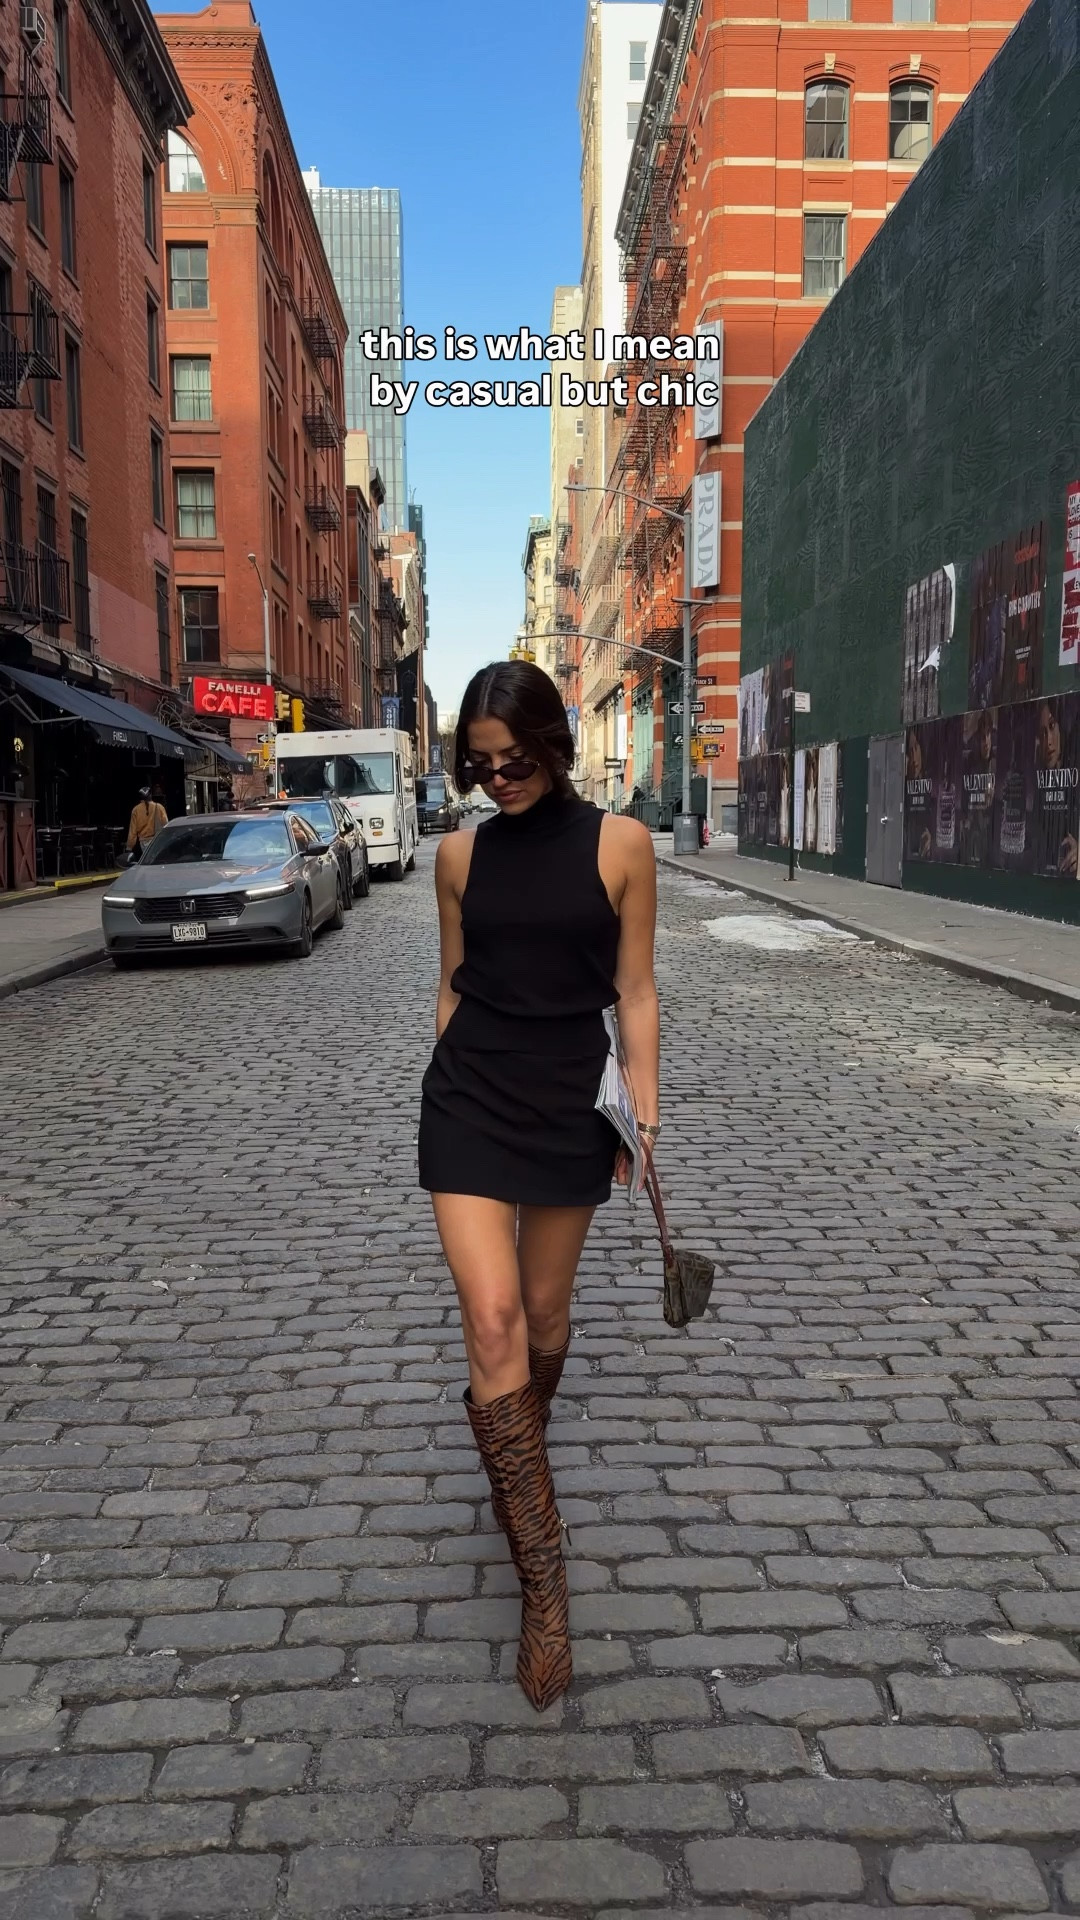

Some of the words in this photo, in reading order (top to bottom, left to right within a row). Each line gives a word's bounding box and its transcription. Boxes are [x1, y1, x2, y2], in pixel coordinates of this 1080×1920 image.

[698, 473, 715, 586] PRADA
[208, 682, 261, 695] FANELLI
[707, 677, 713, 685] St
[201, 693, 267, 717] CAFE
[907, 777, 933, 795] VALENTINO
[963, 773, 996, 791] VALENTINO
[1036, 767, 1079, 789] VALENTINO
